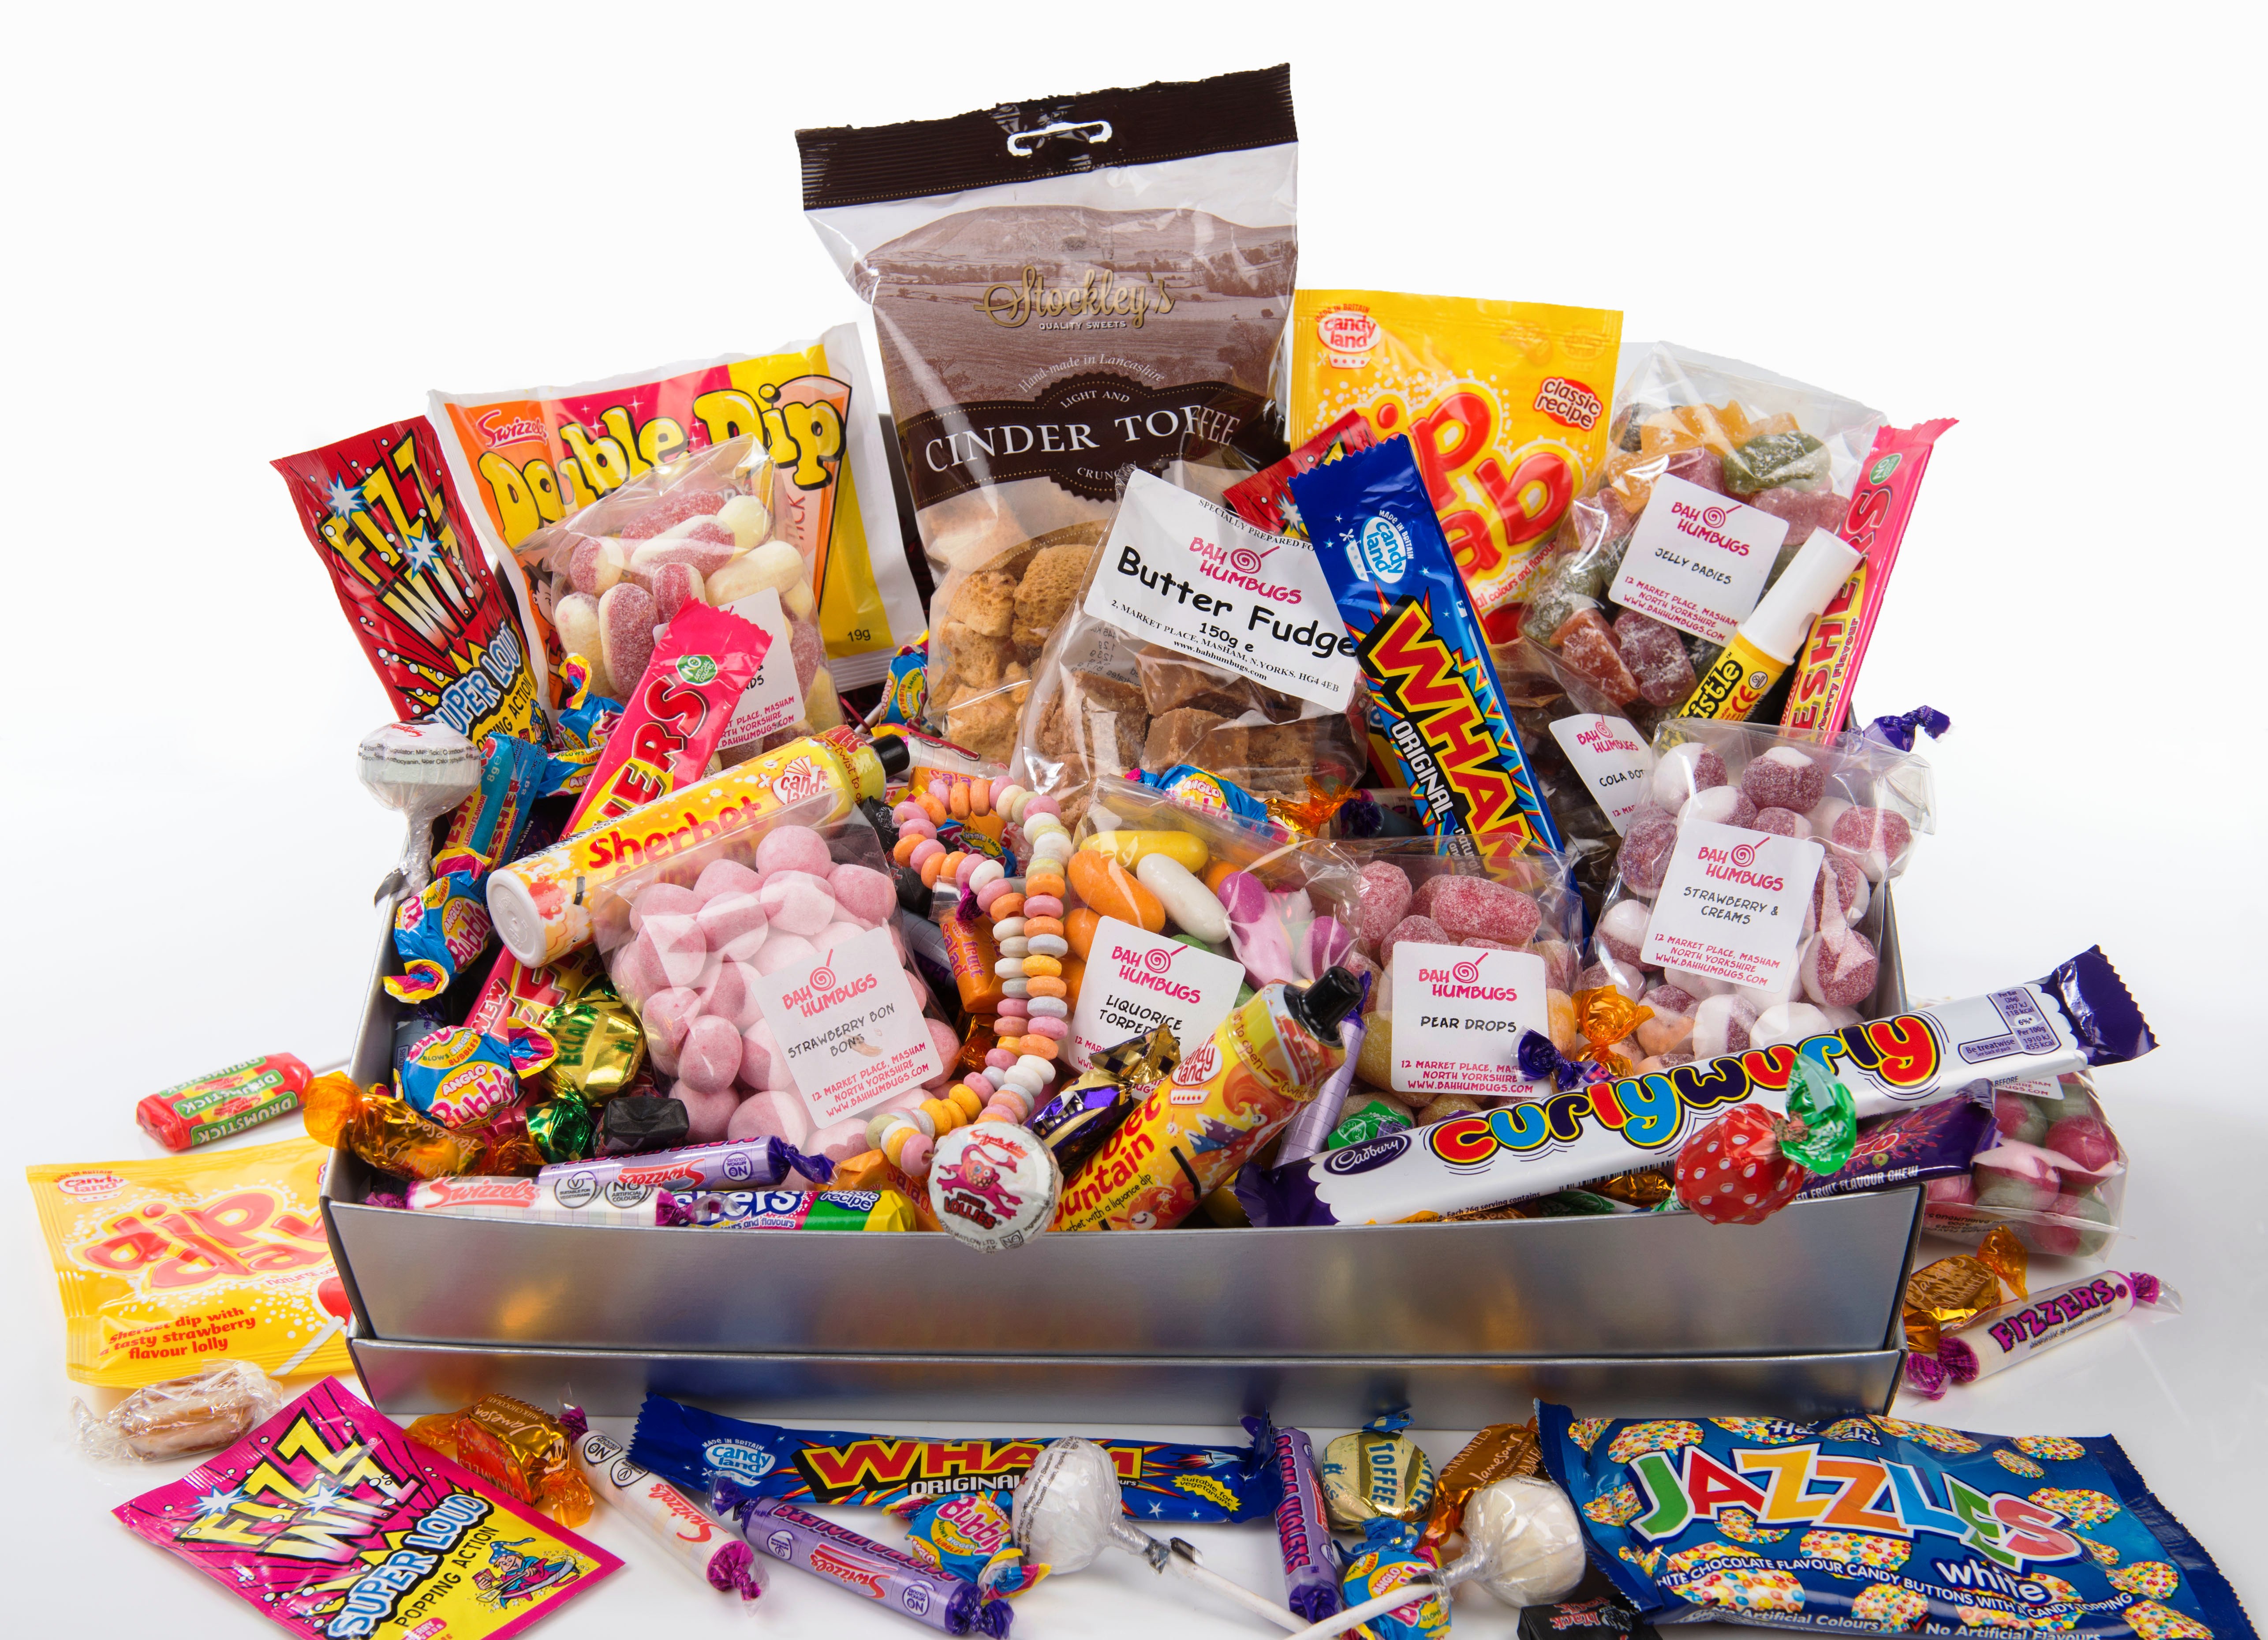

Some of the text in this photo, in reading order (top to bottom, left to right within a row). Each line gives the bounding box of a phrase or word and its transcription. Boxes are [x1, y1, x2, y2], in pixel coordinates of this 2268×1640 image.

[974, 265, 1175, 328] Stockley's
[1039, 322, 1083, 330] QUALITY
[1324, 312, 1376, 338] candy
[1330, 331, 1368, 349] land
[1017, 354, 1165, 394] Hand-made in Lancashire
[1060, 389, 1130, 408] LIGHT AND
[1536, 395, 1594, 428] recipe
[1543, 378, 1601, 416] classic
[476, 410, 547, 448] Swizzels
[694, 384, 846, 490] Dip
[925, 404, 1240, 473] CINDER TOFFEE
[321, 431, 445, 587] FIZZ
[1198, 499, 1315, 552] SPECIALLY PREPARED FO
[1672, 502, 1700, 522] BAH
[1189, 537, 1228, 565] BAH
[1375, 521, 1406, 575] candy
[1678, 518, 1749, 557] HUMBUGS
[1366, 539, 1389, 573] land
[1655, 547, 1732, 585] JELLY BABIES
[1199, 559, 1302, 604] HUMBUGS
[1117, 545, 1357, 659] Butter Fudge
[1623, 594, 1725, 641] WWW.BAHHUMBUGS.COM
[1635, 580, 1670, 599] MARKET
[1672, 594, 1699, 611] PLACE,
[1703, 608, 1738, 626] MASHAM
[1639, 591, 1716, 628] NORTH YORKSHIRE
[847, 628, 871, 641] 19g
[1111, 599, 1339, 693] 2, MARKET PLACE, MASHAM, N.YORKS. HG4 4EB
[1199, 622, 1239, 649] 150g
[1174, 640, 1267, 681] www.bahhumbugs.com
[423, 675, 499, 740] UPER
[737, 696, 795, 729] PLACE, MASHAM
[740, 711, 782, 737] YORKSHIRE
[1577, 731, 1599, 745] BAH
[1593, 739, 1639, 753] HUMBUGS
[1391, 720, 1455, 822] ORIGINAL
[1599, 772, 1627, 787] COLA
[1182, 780, 1221, 798] ANGLO
[588, 796, 763, 870] Sherbet
[1698, 846, 1728, 864] BAH
[1706, 864, 1783, 891] HUMBUGS
[444, 900, 463, 933] ANGLO
[1684, 887, 1778, 915] STRAWBERRY &
[1701, 906, 1750, 924] CREAMS
[1112, 946, 1143, 967] BAH
[1667, 936, 1704, 951] MARKET
[1706, 945, 1736, 958] PLACE,
[1740, 953, 1780, 969] MASHAM
[1670, 947, 1756, 973] NORTH YORKSHIRE
[1119, 965, 1201, 1004] HUMBUGS
[1419, 968, 1449, 983] BAH
[1655, 954, 1768, 985] WWW.BAHHUMBUGS.COM
[782, 984, 812, 1010] BAH
[800, 974, 877, 1018] HUMBUGS
[1432, 984, 1517, 1001] HUMBUGS
[1106, 995, 1183, 1030] LIQUORICE
[1421, 1016, 1517, 1033] PEAR DROPS
[2018, 1006, 2035, 1015] kcal
[788, 1003, 894, 1059] STRAWBERRY BON
[1236, 1024, 1263, 1069] to open
[1965, 1038, 2015, 1054] Be treatwise
[2017, 1025, 2046, 1037] Per 100g
[2040, 1039, 2055, 1048] kcal
[448, 1038, 479, 1067] BUBBLES
[1401, 1060, 1492, 1072] 12 MARKET PLACE,
[442, 1064, 487, 1096] ANGLO
[811, 1042, 926, 1101] 12 MARKET PLACE, MASHAM
[834, 1060, 914, 1103] NORTH YORKSHIRE
[1408, 1081, 1533, 1093] WWW.BAHHUMBUGS.COM
[1423, 1071, 1517, 1082] NORTH YORKSHIRE
[1995, 1076, 2018, 1086] BEFORE
[430, 1069, 518, 1131] Bubbly
[826, 1063, 929, 1117] WWW.BAHHUMBUGS.COM
[1431, 1016, 1940, 1164] curlywurly
[197, 1096, 292, 1144] DRUMSTICK
[1331, 1139, 1399, 1172] Cadbury
[424, 1176, 541, 1208] Swizzels
[1811, 1166, 1919, 1199] FRUIT FLAVOUR CHEW
[820, 1192, 875, 1210] recipe
[944, 1197, 998, 1230] LOLLIES
[1480, 1200, 1507, 1211] serving
[1509, 1192, 1540, 1204] contains
[85, 1193, 275, 1274] dip
[744, 1217, 795, 1228] and flavours
[108, 1307, 244, 1345] sherbet dip with
[1988, 1279, 2116, 1353] FIZZERS
[112, 1334, 157, 1350] tasty
[163, 1317, 256, 1342] strawberry
[129, 1337, 228, 1360] flavour lolly
[712, 1446, 771, 1468] candy
[719, 1457, 761, 1474] land
[1440, 1427, 1492, 1478] CARAMELS
[1468, 1433, 1525, 1484] Jameson's
[180, 1415, 363, 1547] FIZZ
[1366, 1442, 1397, 1508] TOFFEE
[1180, 1480, 1232, 1509] vegetarians
[1629, 1443, 2083, 1574] JAZZLES
[650, 1483, 729, 1543] Swizzels
[938, 1494, 1012, 1555] Bubbly
[327, 1493, 491, 1639] SUPER LOUD
[395, 1524, 500, 1629] POPPING ACTION
[811, 1544, 895, 1600] Swizzels
[1371, 1567, 1401, 1597] ANGLO
[1936, 1557, 2046, 1603] white
[1691, 1556, 1775, 1580] CHOCOLATE
[1777, 1558, 1843, 1575] FLAVOUR
[1846, 1563, 1900, 1582] CANDY
[1903, 1577, 1973, 1606] BUTTONS
[1976, 1595, 2017, 1614] WITH
[2017, 1605, 2027, 1617] A
[2028, 1602, 2074, 1618] CANDY
[2075, 1591, 2133, 1612] TOPPING
[1712, 1605, 1882, 1631] No Artificial Colours
[1925, 1623, 1951, 1636] No
[1954, 1624, 2027, 1639] Artificial
